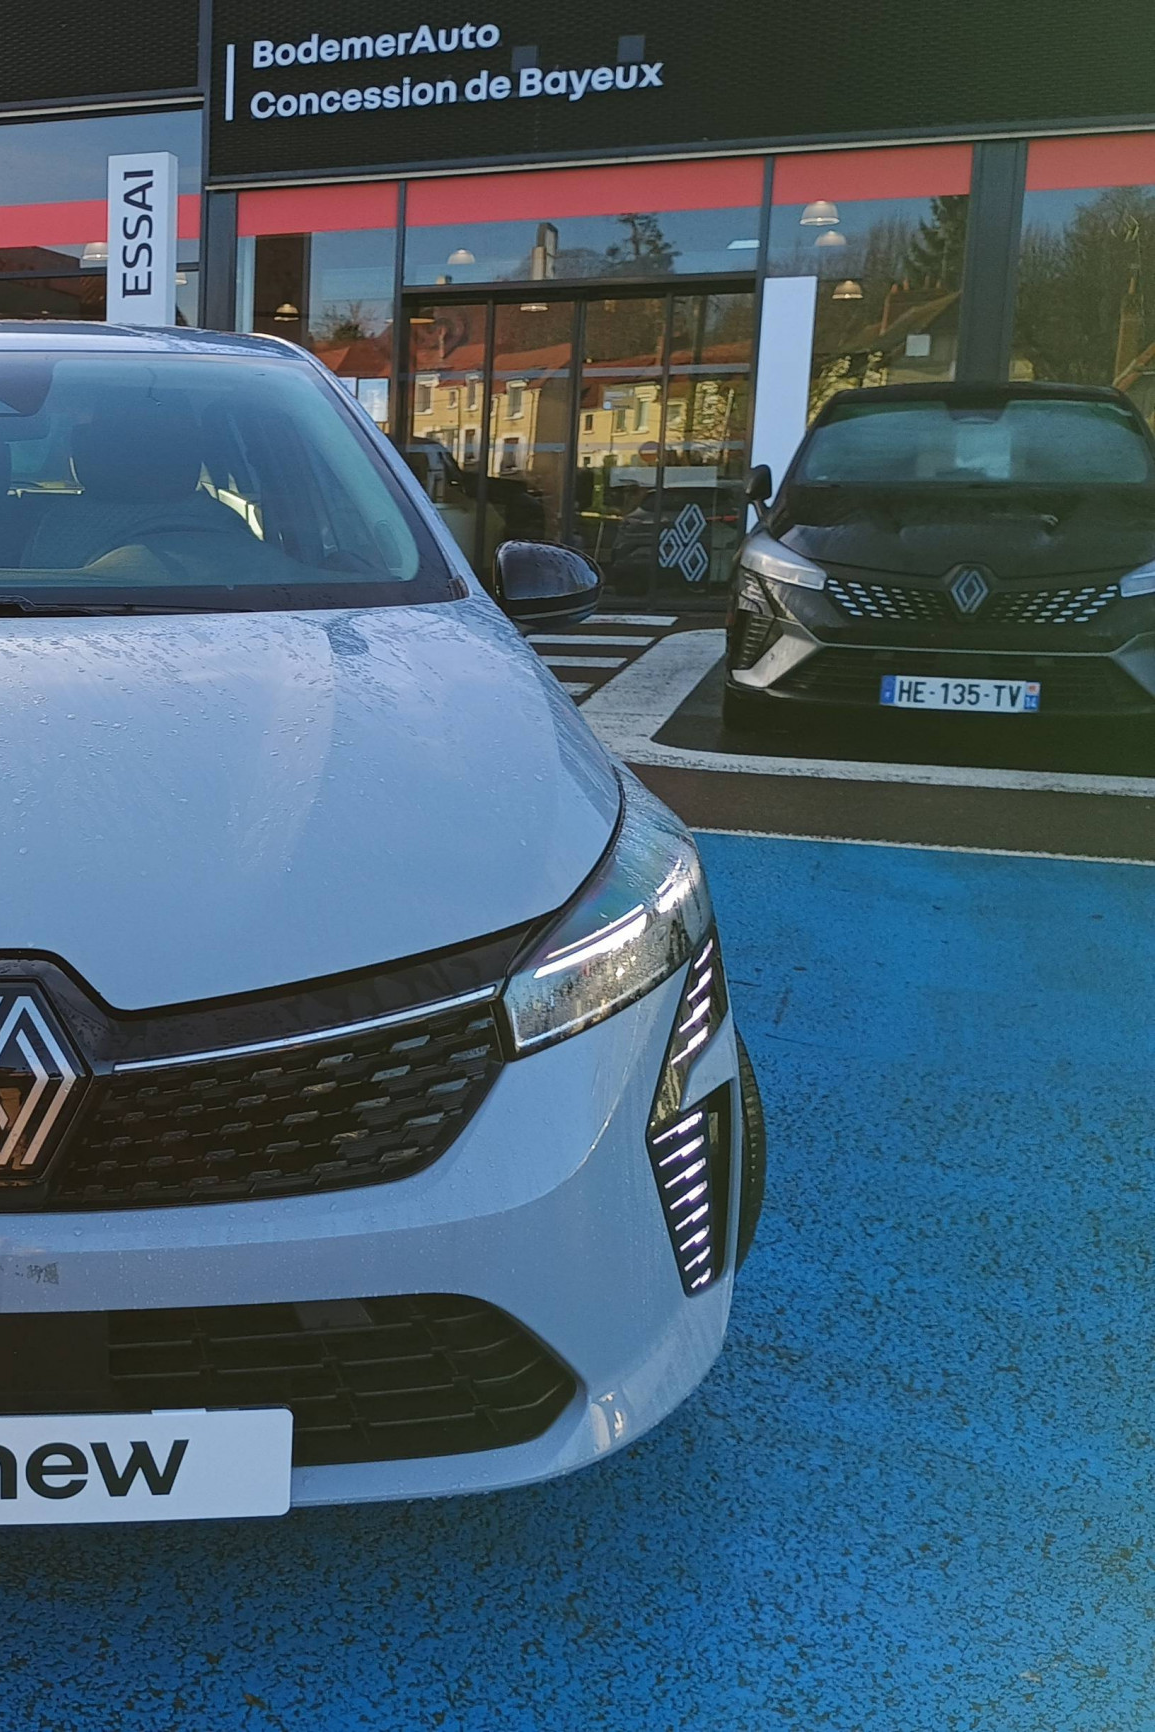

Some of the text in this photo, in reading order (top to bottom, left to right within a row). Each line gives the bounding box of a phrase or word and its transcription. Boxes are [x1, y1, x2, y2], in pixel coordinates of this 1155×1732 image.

[252, 22, 501, 68] BodemerAuto
[250, 61, 664, 119] Concession de Bayeux
[122, 169, 153, 298] ESSAI
